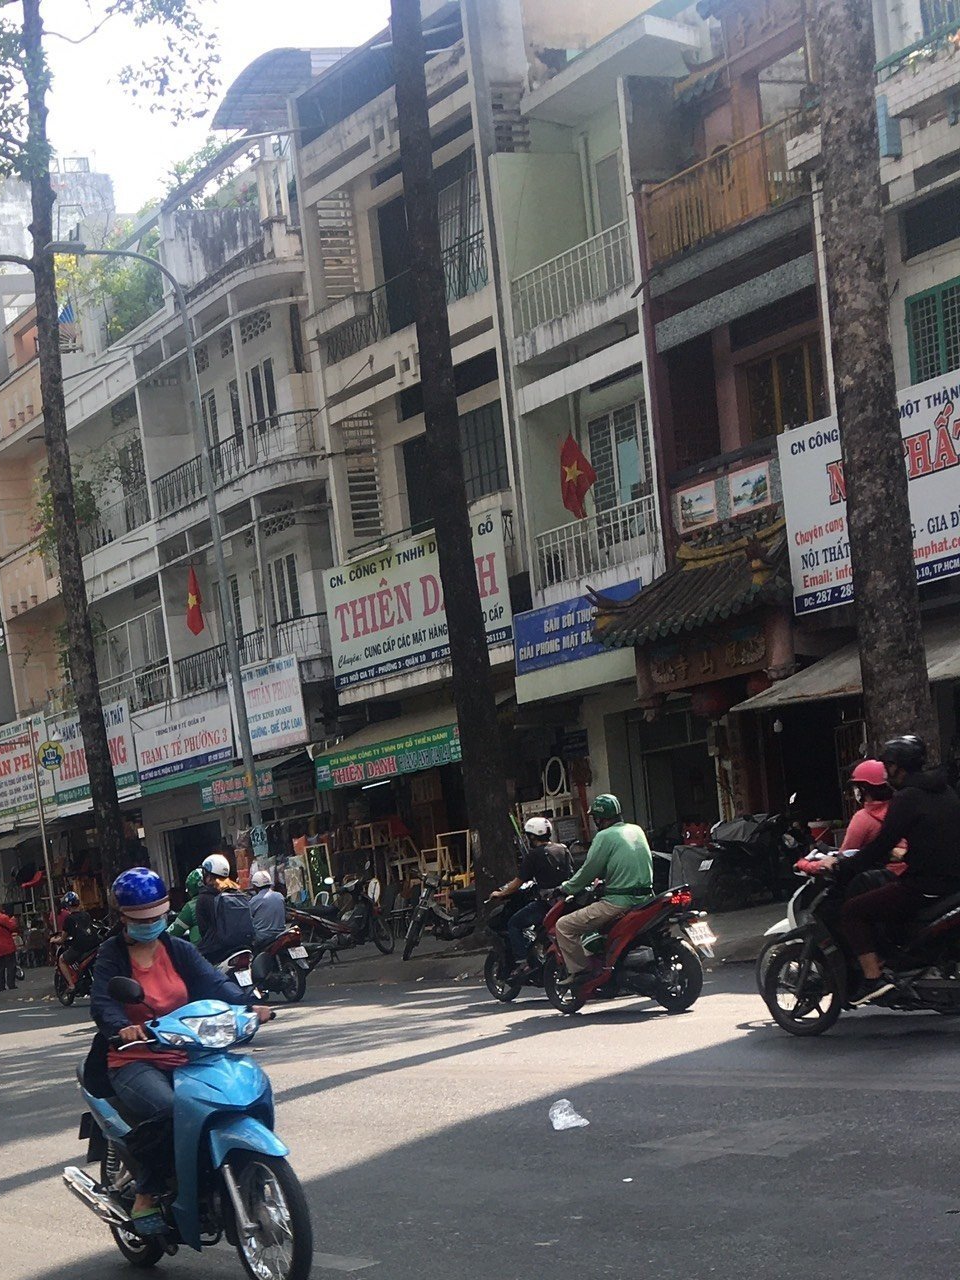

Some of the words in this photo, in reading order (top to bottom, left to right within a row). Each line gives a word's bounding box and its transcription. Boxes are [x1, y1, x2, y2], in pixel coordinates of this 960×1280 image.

[790, 438, 806, 456] CN
[808, 428, 839, 450] CÔNG
[924, 385, 960, 409] THÀN
[329, 574, 346, 589] CN.
[349, 562, 377, 582] CÔNG
[379, 556, 393, 571] TY
[395, 546, 425, 565] TNHH
[477, 513, 494, 536] GỖ
[795, 525, 824, 547] Chuyên
[801, 549, 820, 572] NỘI
[822, 536, 851, 562] THẤT
[927, 514, 949, 535] GIA
[803, 571, 833, 590] Email:
[816, 589, 832, 604] 287
[334, 577, 413, 643] THIÊN
[543, 616, 560, 634] BAN
[363, 644, 382, 660] CUNG
[382, 633, 397, 655] CẤP
[397, 631, 411, 650] CÁC
[489, 602, 504, 623] CẤP
[519, 640, 535, 662] GIẢI
[535, 636, 561, 657] PHÓNG
[140, 747, 163, 767] TRẠM
[162, 745, 169, 760] Y
[170, 734, 184, 758] TẾ
[184, 726, 221, 753] PHƯỜNG
[222, 727, 228, 742] 3
[331, 760, 364, 785] THIÊN
[367, 755, 397, 778] DANH
